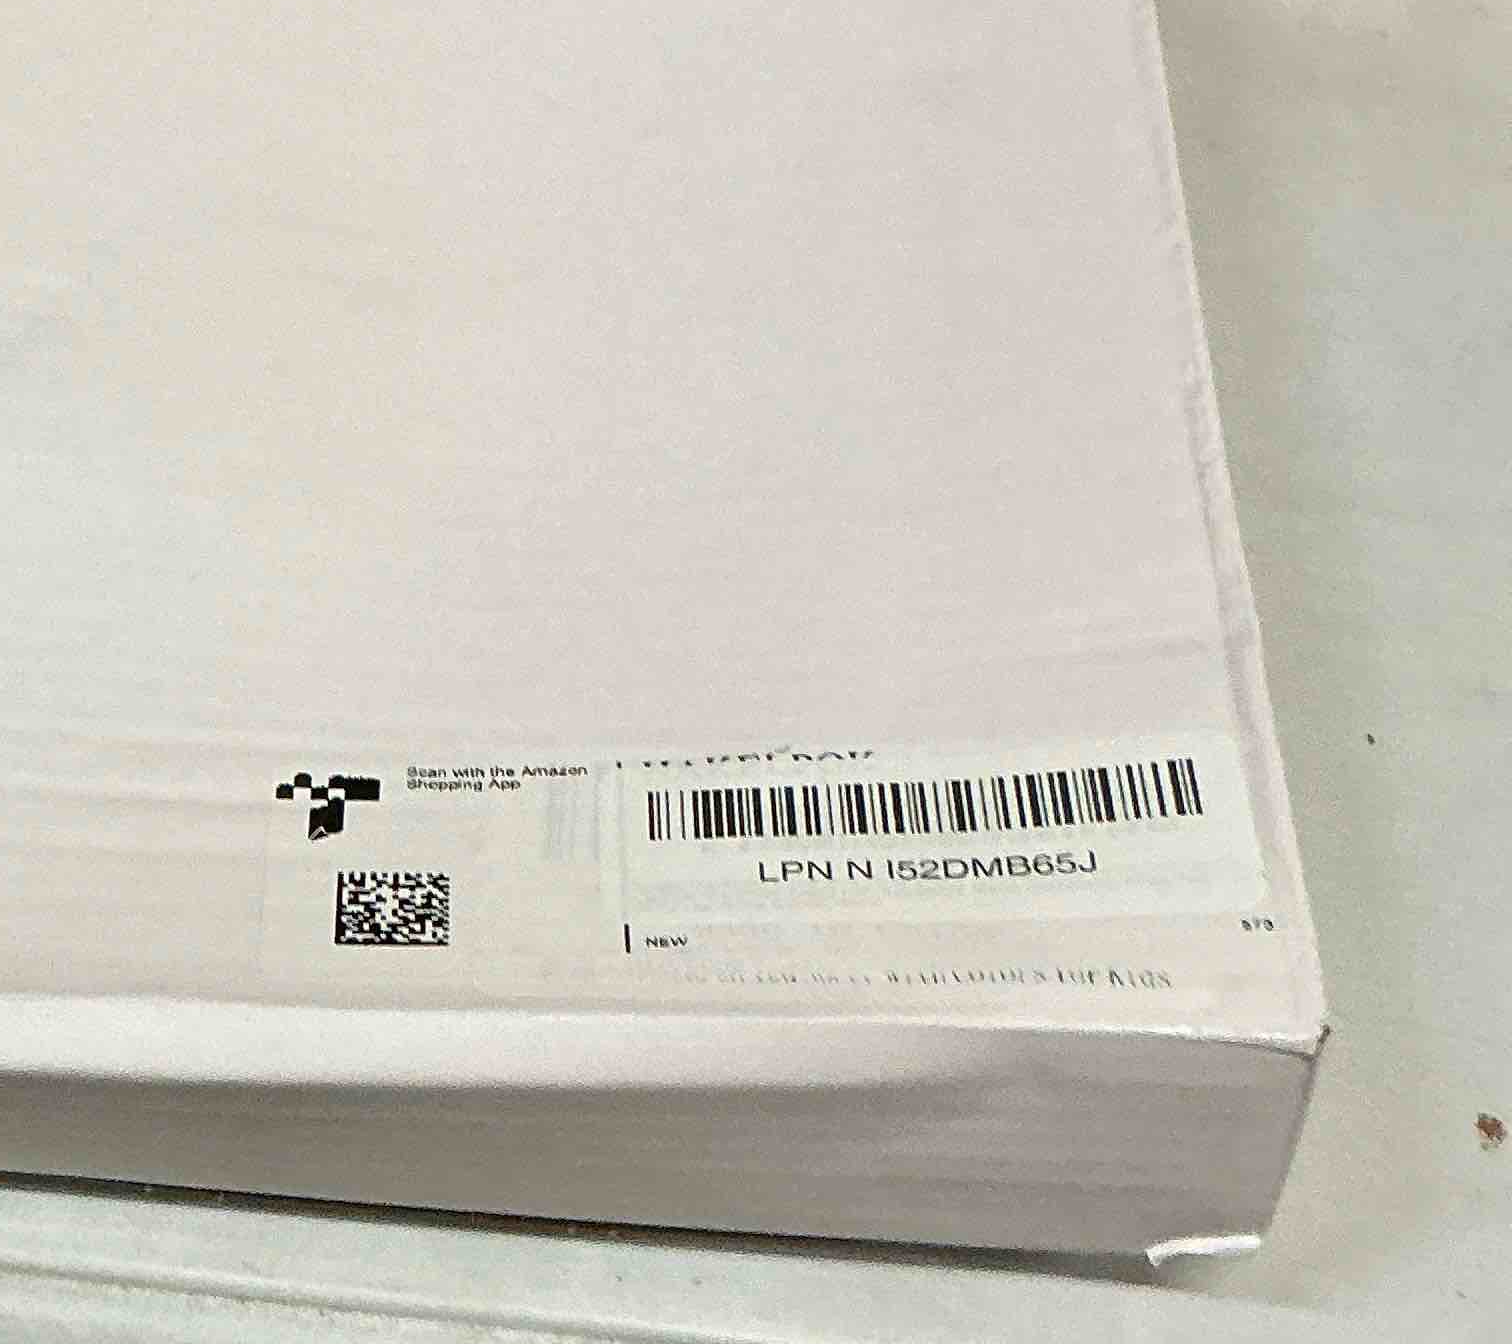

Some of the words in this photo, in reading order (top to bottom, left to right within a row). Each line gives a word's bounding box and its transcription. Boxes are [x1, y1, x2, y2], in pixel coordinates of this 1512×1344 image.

[452, 766, 485, 778] with
[489, 765, 515, 777] the
[521, 764, 588, 777] Amazon
[406, 779, 483, 793] Shopping
[488, 779, 521, 792] App
[758, 860, 833, 883] LPN
[847, 860, 873, 880] N
[645, 935, 688, 949] NEW
